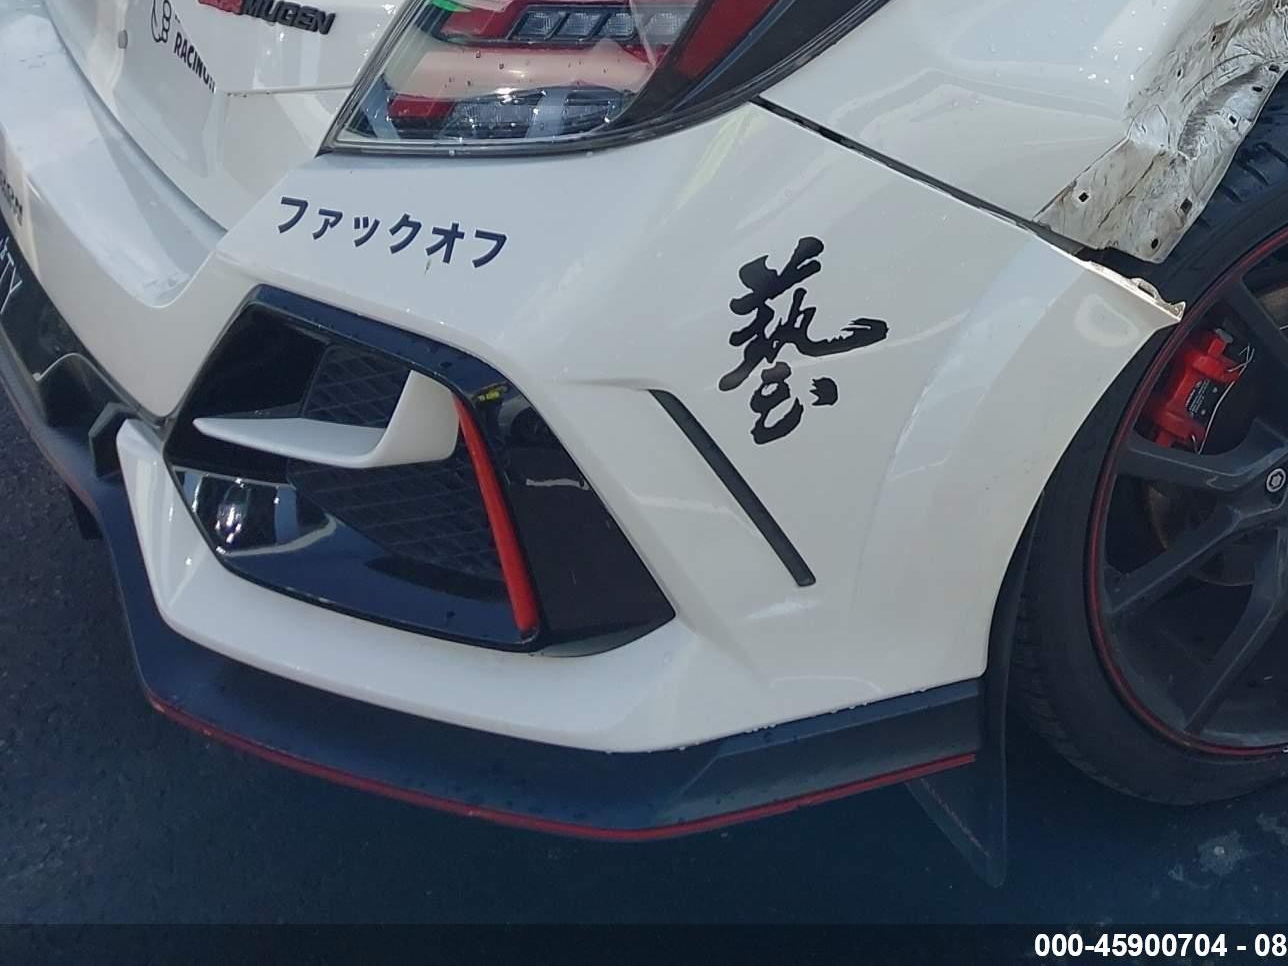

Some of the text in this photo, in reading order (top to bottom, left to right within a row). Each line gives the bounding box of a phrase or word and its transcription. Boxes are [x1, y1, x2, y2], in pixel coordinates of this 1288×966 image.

[277, 196, 507, 269] ファックオフ
